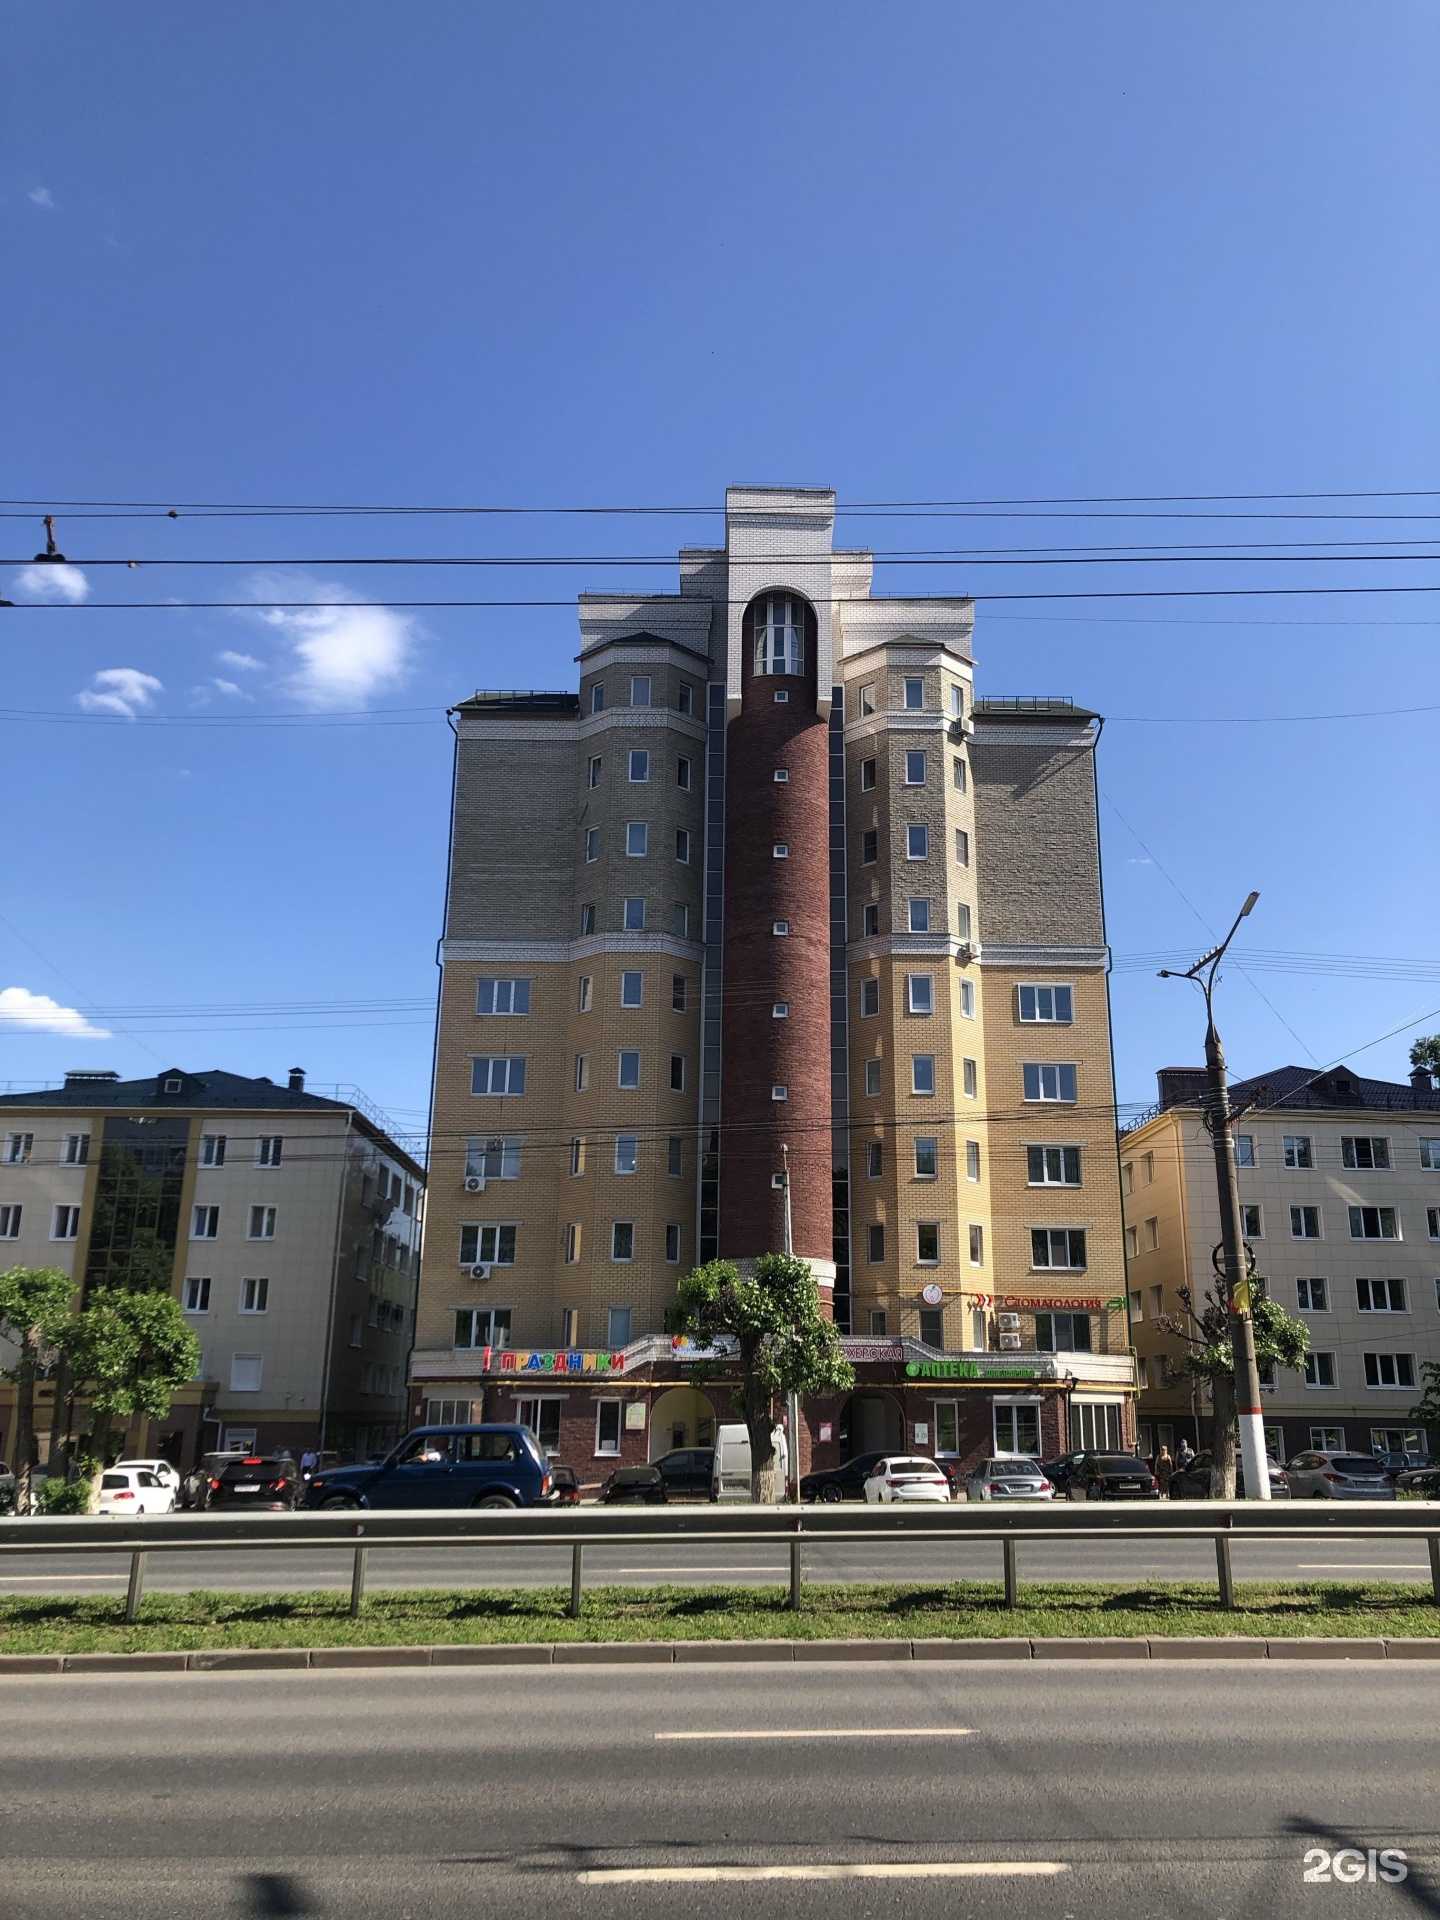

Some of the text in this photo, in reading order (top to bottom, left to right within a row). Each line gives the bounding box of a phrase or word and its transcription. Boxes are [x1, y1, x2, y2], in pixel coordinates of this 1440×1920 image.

[846, 1346, 904, 1360] ХЕРСКАЯ
[501, 1352, 625, 1372] ПРАЗДНИКИ
[921, 1360, 981, 1377] АПТЕКА
